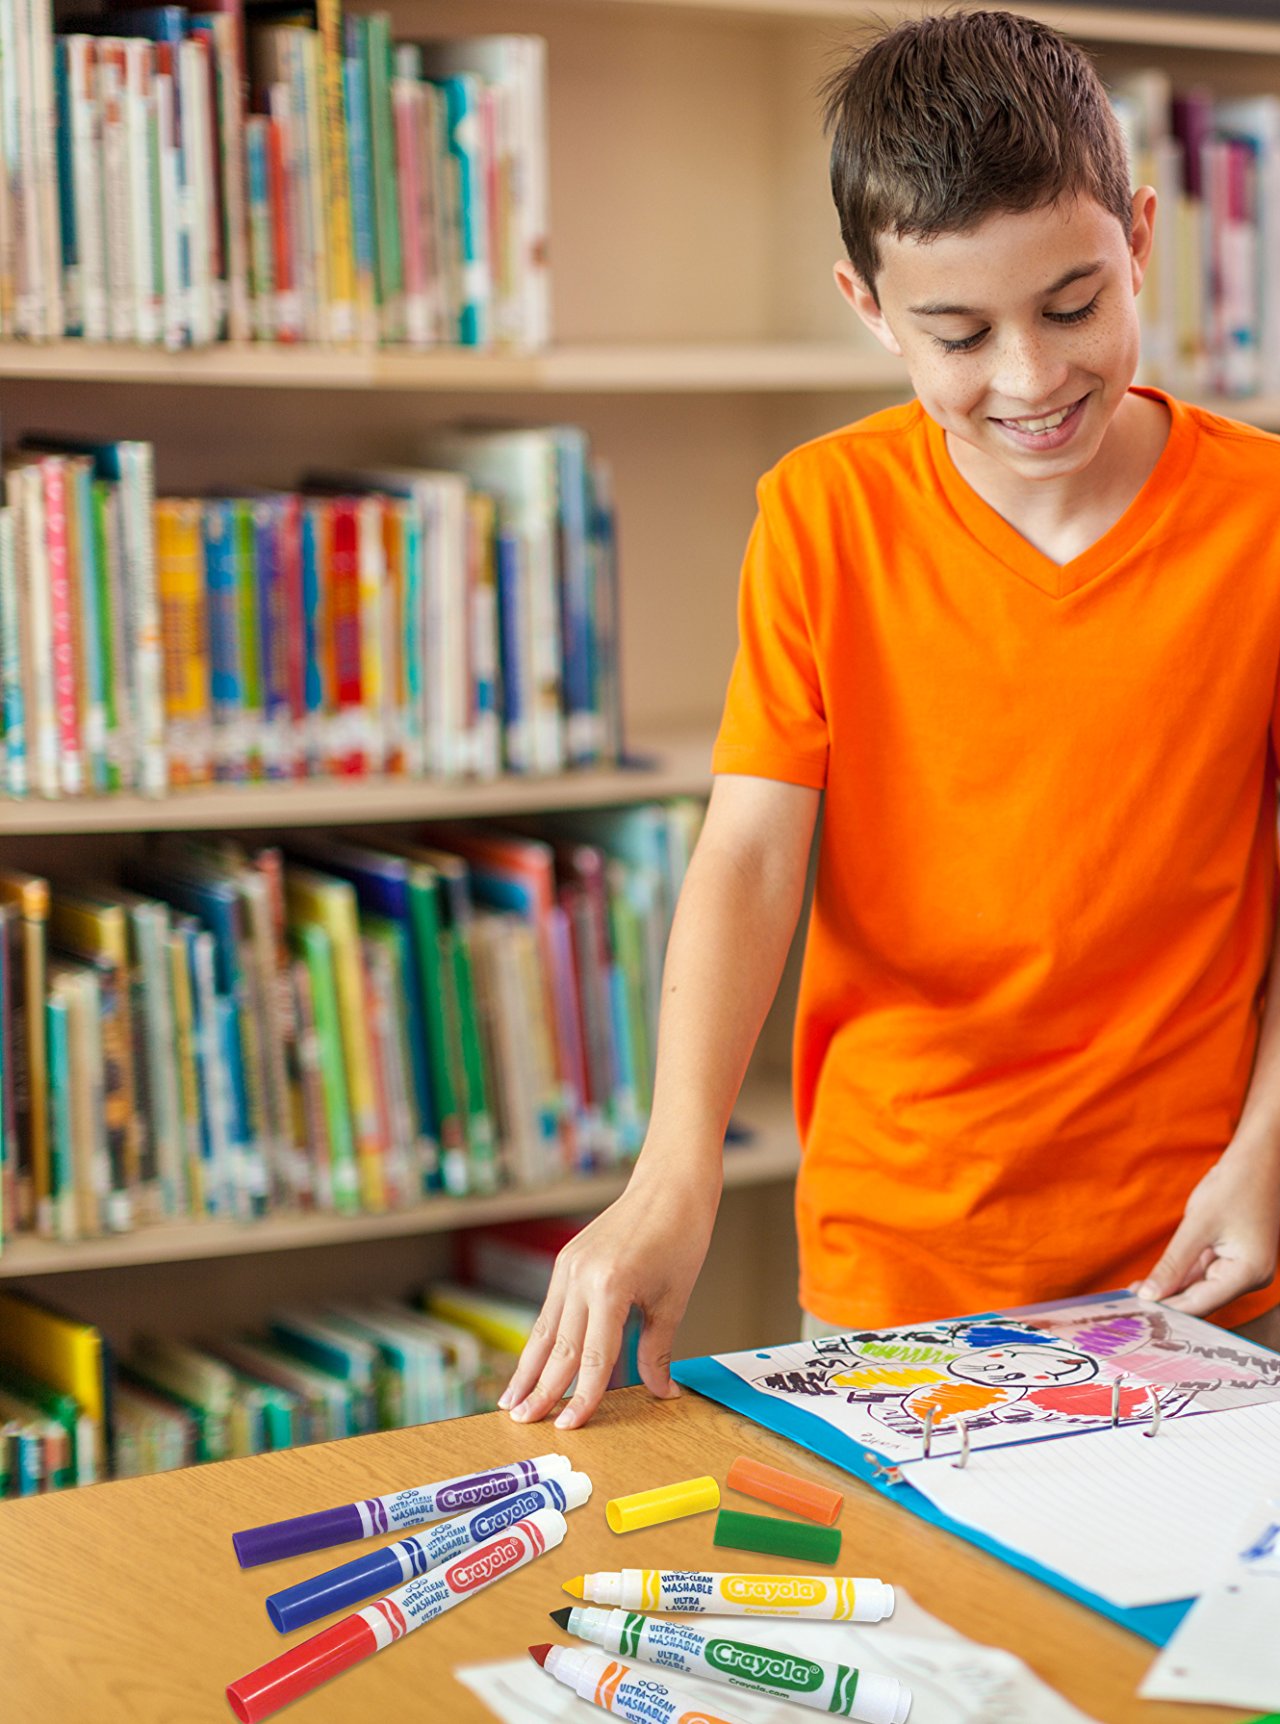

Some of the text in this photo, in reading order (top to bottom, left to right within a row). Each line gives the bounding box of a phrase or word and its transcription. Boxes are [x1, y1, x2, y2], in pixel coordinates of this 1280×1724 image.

[389, 1495, 433, 1513] ULTRA-CLEAN
[392, 1504, 434, 1523] WASHABLE
[403, 1517, 425, 1527] ULTRA
[426, 1526, 467, 1551] ULTRA-CLEAN
[430, 1534, 470, 1560] WASHABLE
[661, 1574, 713, 1583] ULTRA-CLEAN
[402, 1580, 446, 1608] ULTRA-CLEAN
[661, 1583, 713, 1595] WASHABLE
[408, 1589, 450, 1617] WASHABLE
[673, 1597, 700, 1605] ULTRA
[421, 1606, 443, 1621] ULTRA
[649, 1624, 705, 1644] ULTRA-CLEAN
[647, 1634, 702, 1657] WASHABLE
[657, 1650, 685, 1664] ULTRA
[620, 1683, 676, 1713] ULTRA-CLEAN
[729, 1678, 790, 1700] Crayola.com
[616, 1694, 670, 1724] WASHABLE
